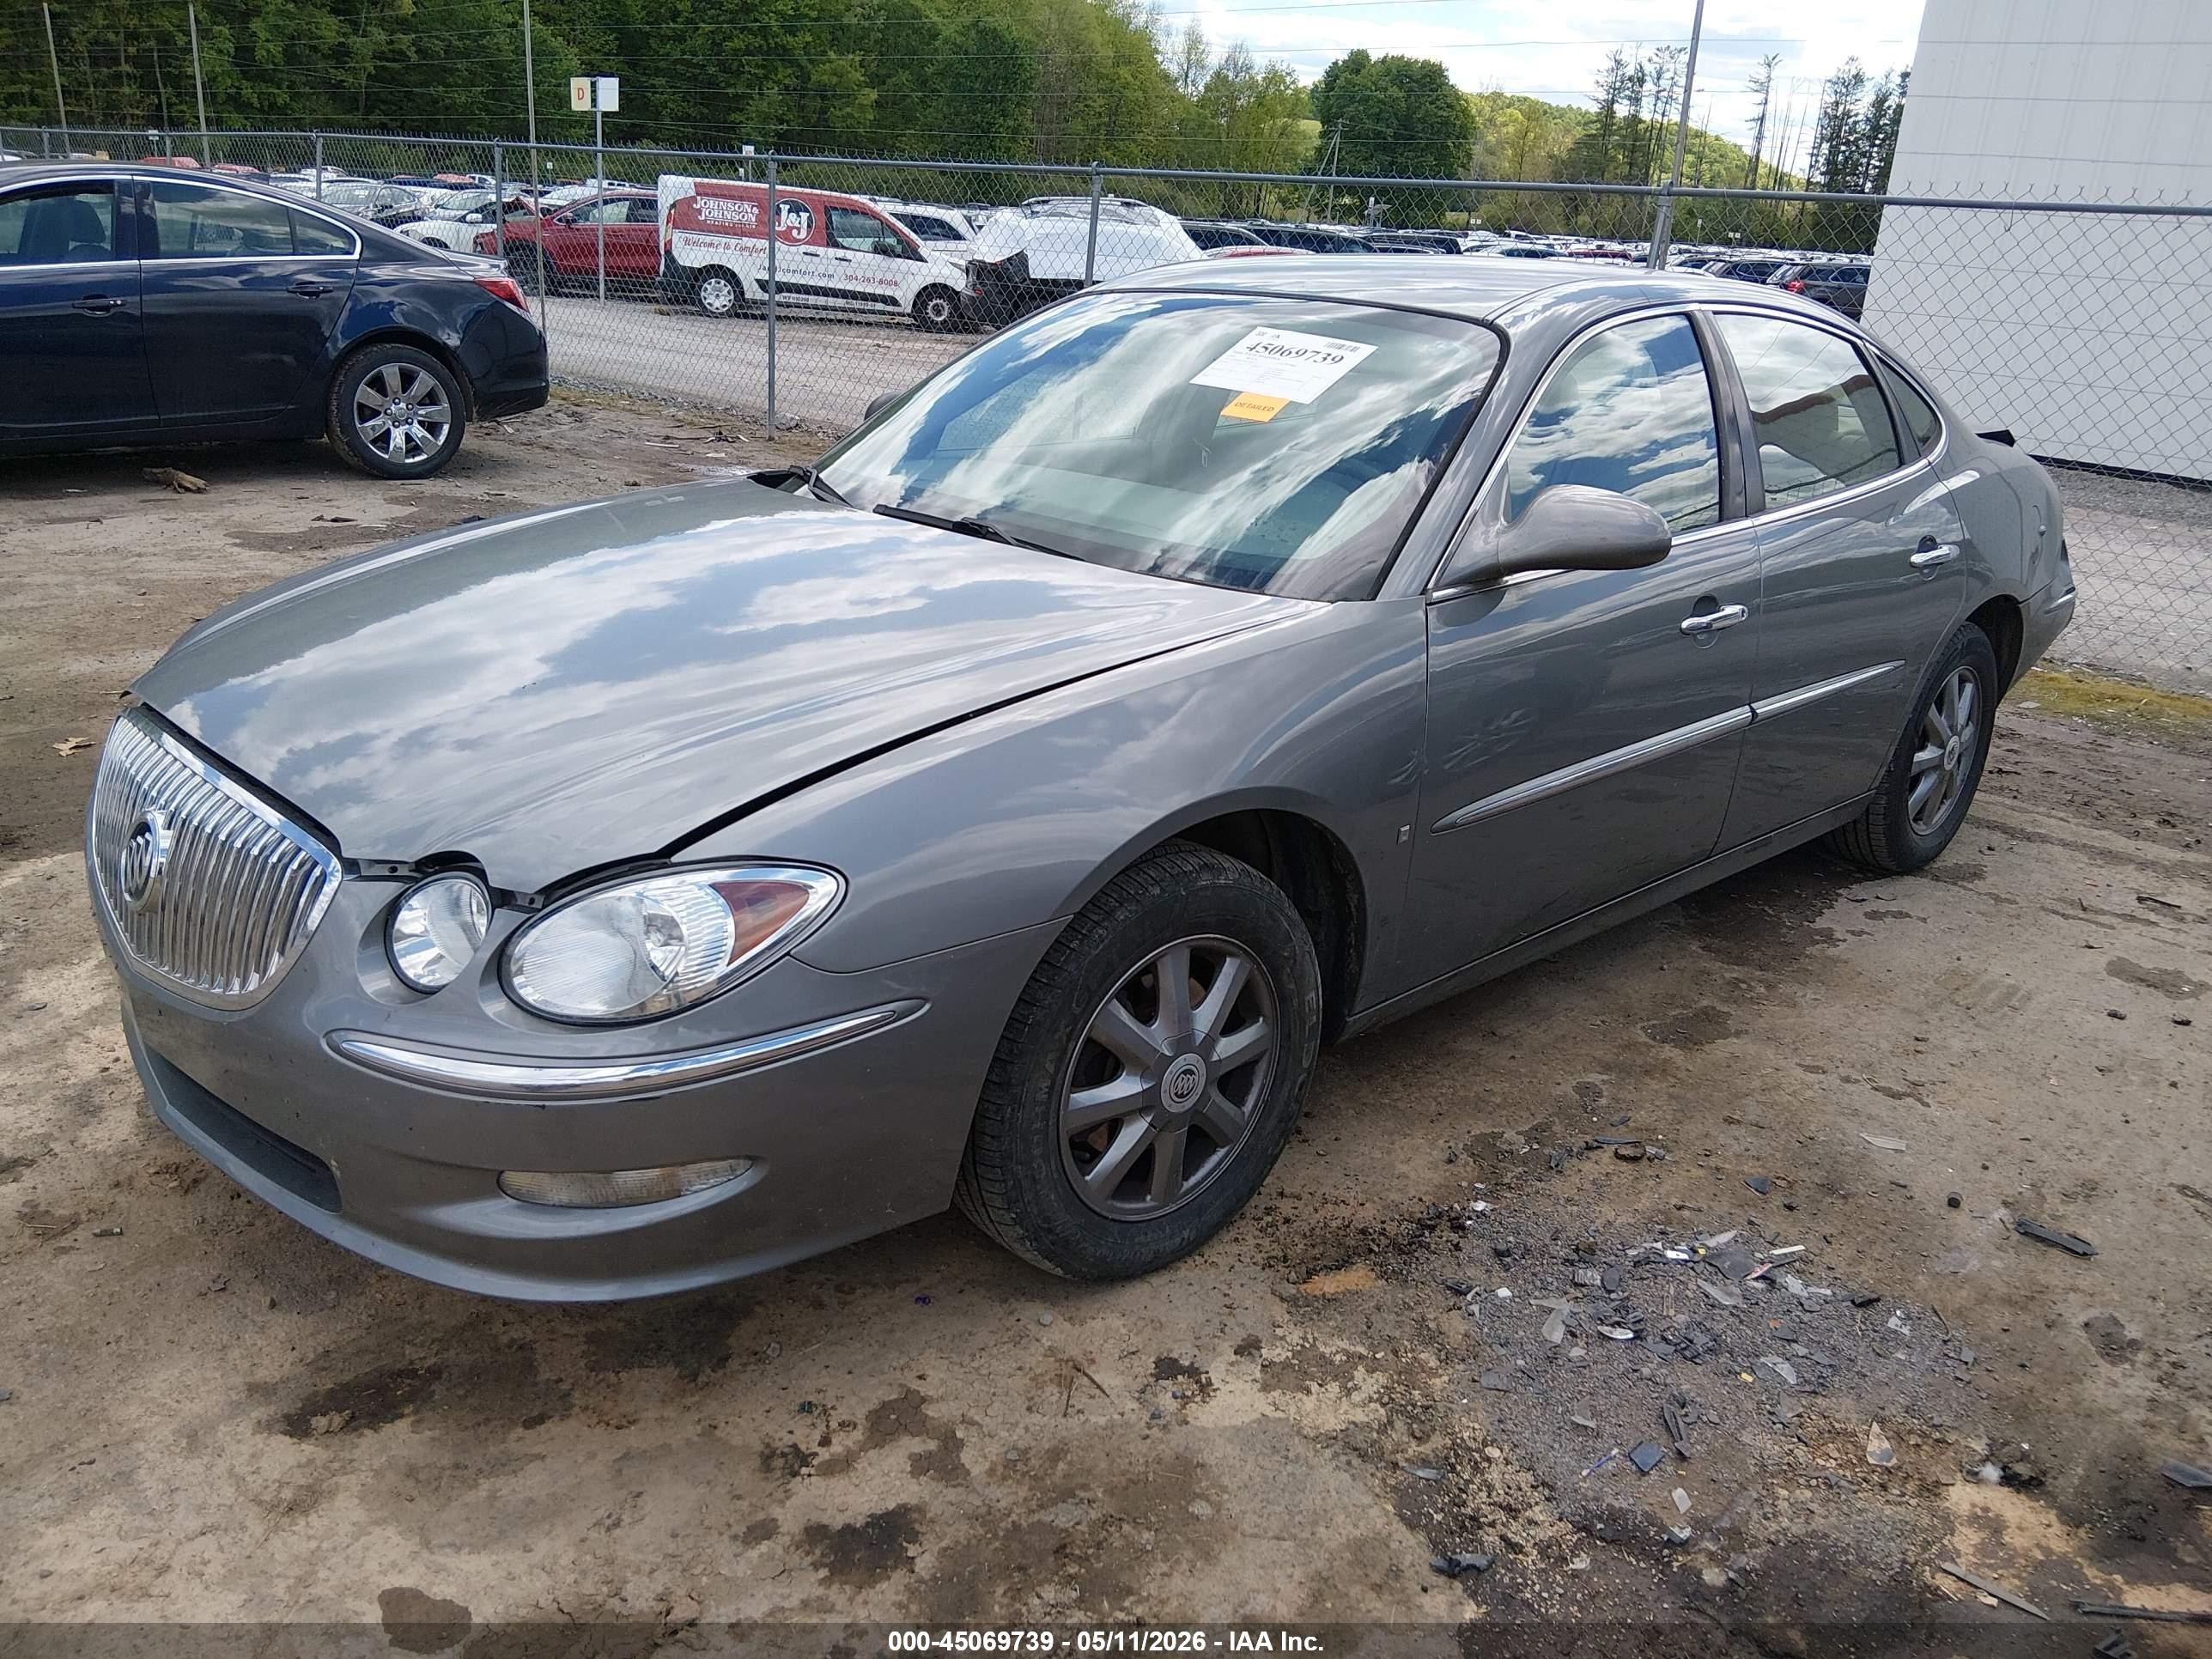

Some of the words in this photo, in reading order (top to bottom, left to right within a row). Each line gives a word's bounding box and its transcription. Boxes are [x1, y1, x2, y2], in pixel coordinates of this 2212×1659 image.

[577, 88, 585, 100] D
[697, 208, 757, 222] JOHNSON
[775, 204, 810, 240] J&J
[682, 235, 721, 250] Welcome
[722, 241, 731, 250] to
[733, 242, 768, 257] Comfort
[1246, 341, 1345, 366] 45069739
[1234, 401, 1275, 412] DETAILED
